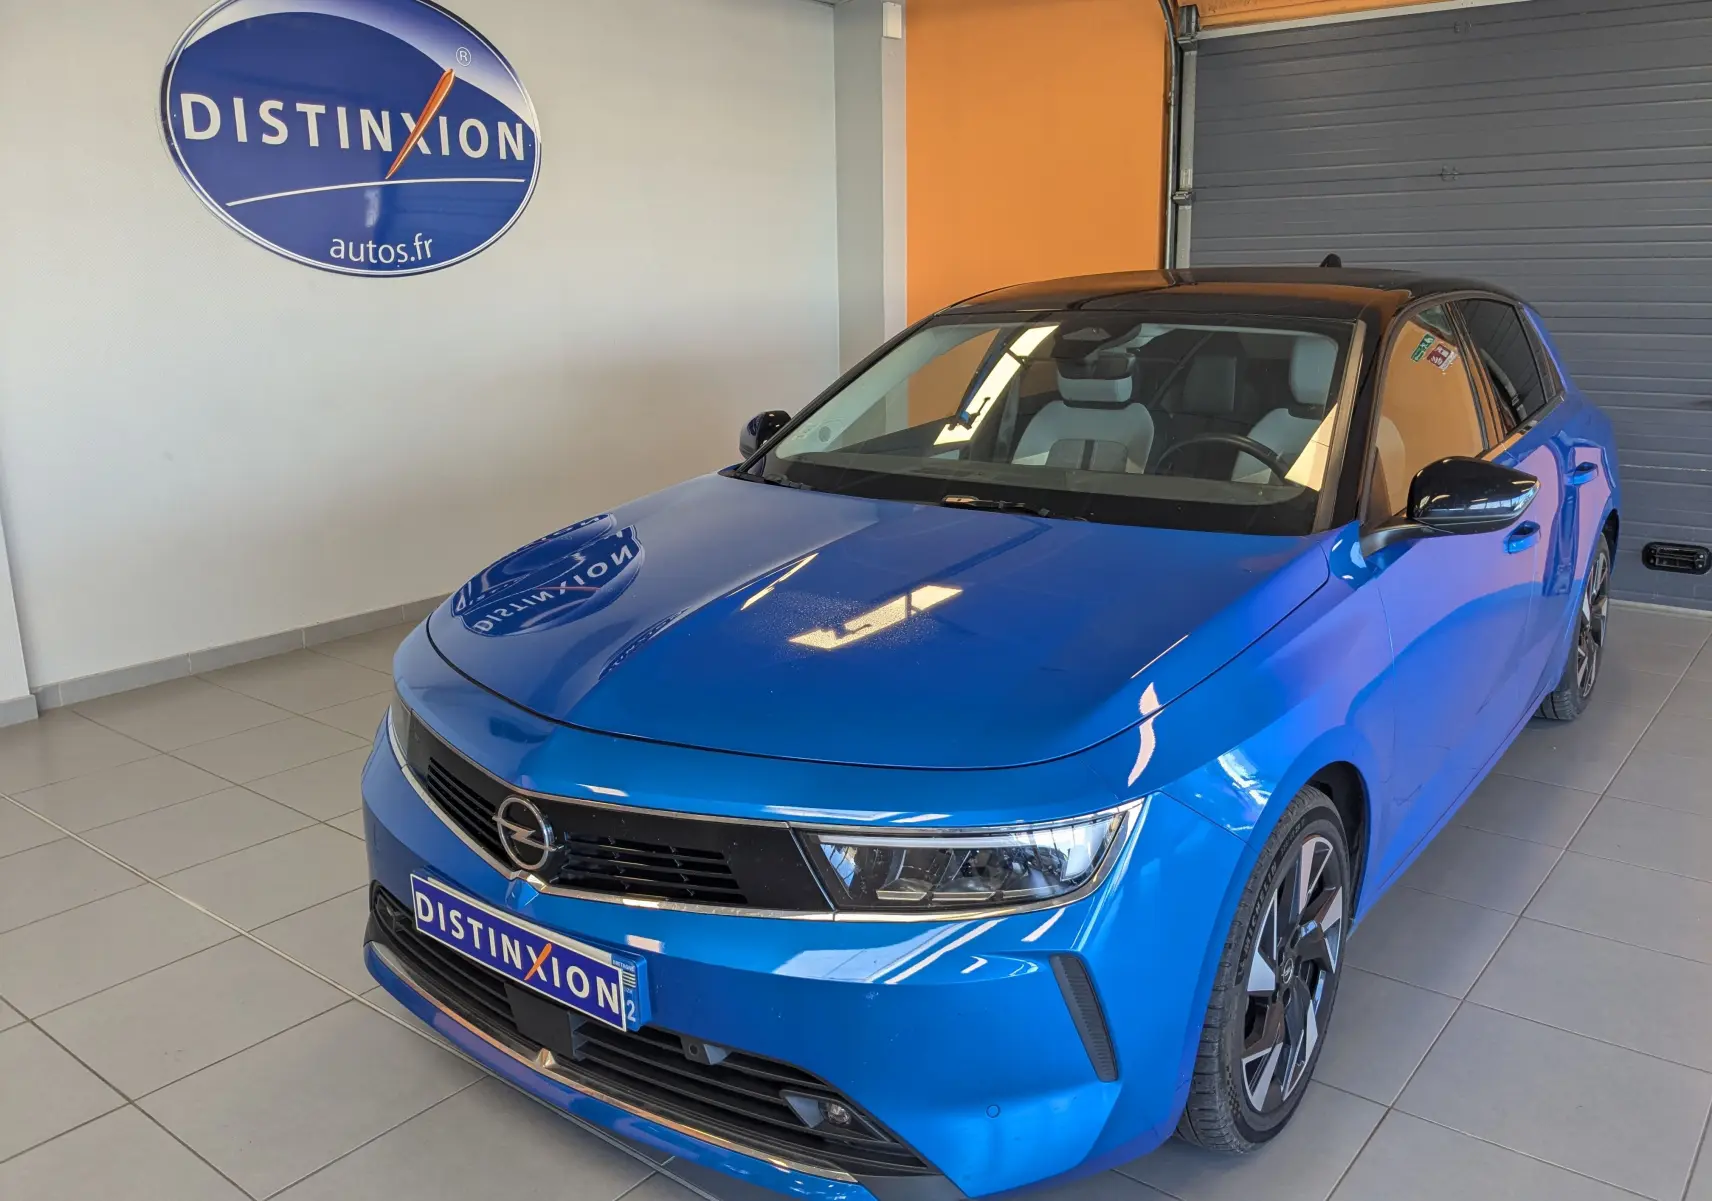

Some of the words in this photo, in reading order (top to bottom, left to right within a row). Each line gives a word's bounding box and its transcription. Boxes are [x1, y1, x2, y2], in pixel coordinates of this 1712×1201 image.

[180, 72, 525, 177] DISTINXION
[330, 233, 432, 264] autos.fr
[415, 891, 619, 1014] DISTINXION
[626, 1000, 636, 1022] 2
